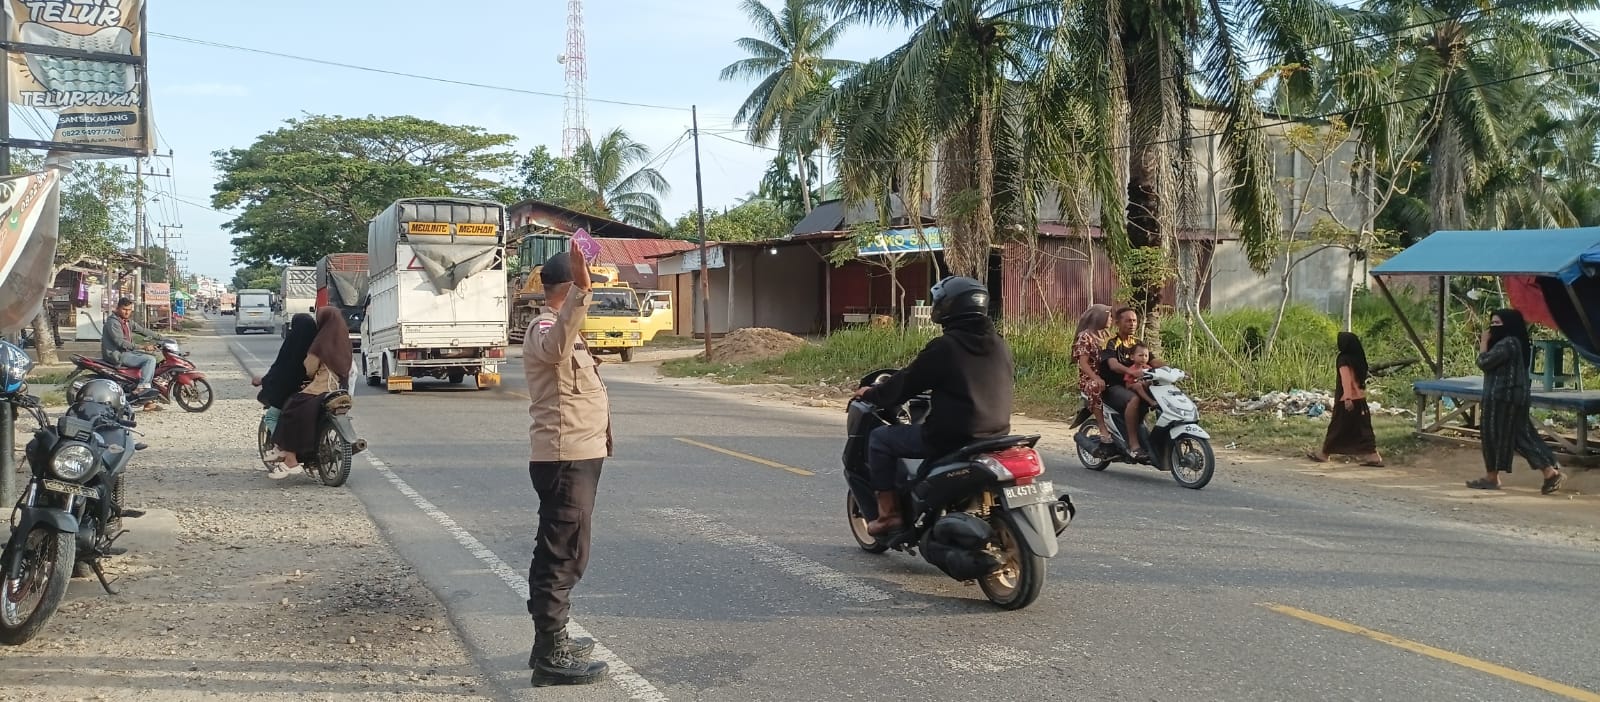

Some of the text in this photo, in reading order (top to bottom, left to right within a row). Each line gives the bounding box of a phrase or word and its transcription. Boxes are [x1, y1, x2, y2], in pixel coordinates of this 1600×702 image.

[26, 1, 121, 27] TELUR
[20, 91, 84, 107] TELUR
[79, 114, 128, 123] SEKARANG
[1006, 488, 1018, 498] BL
